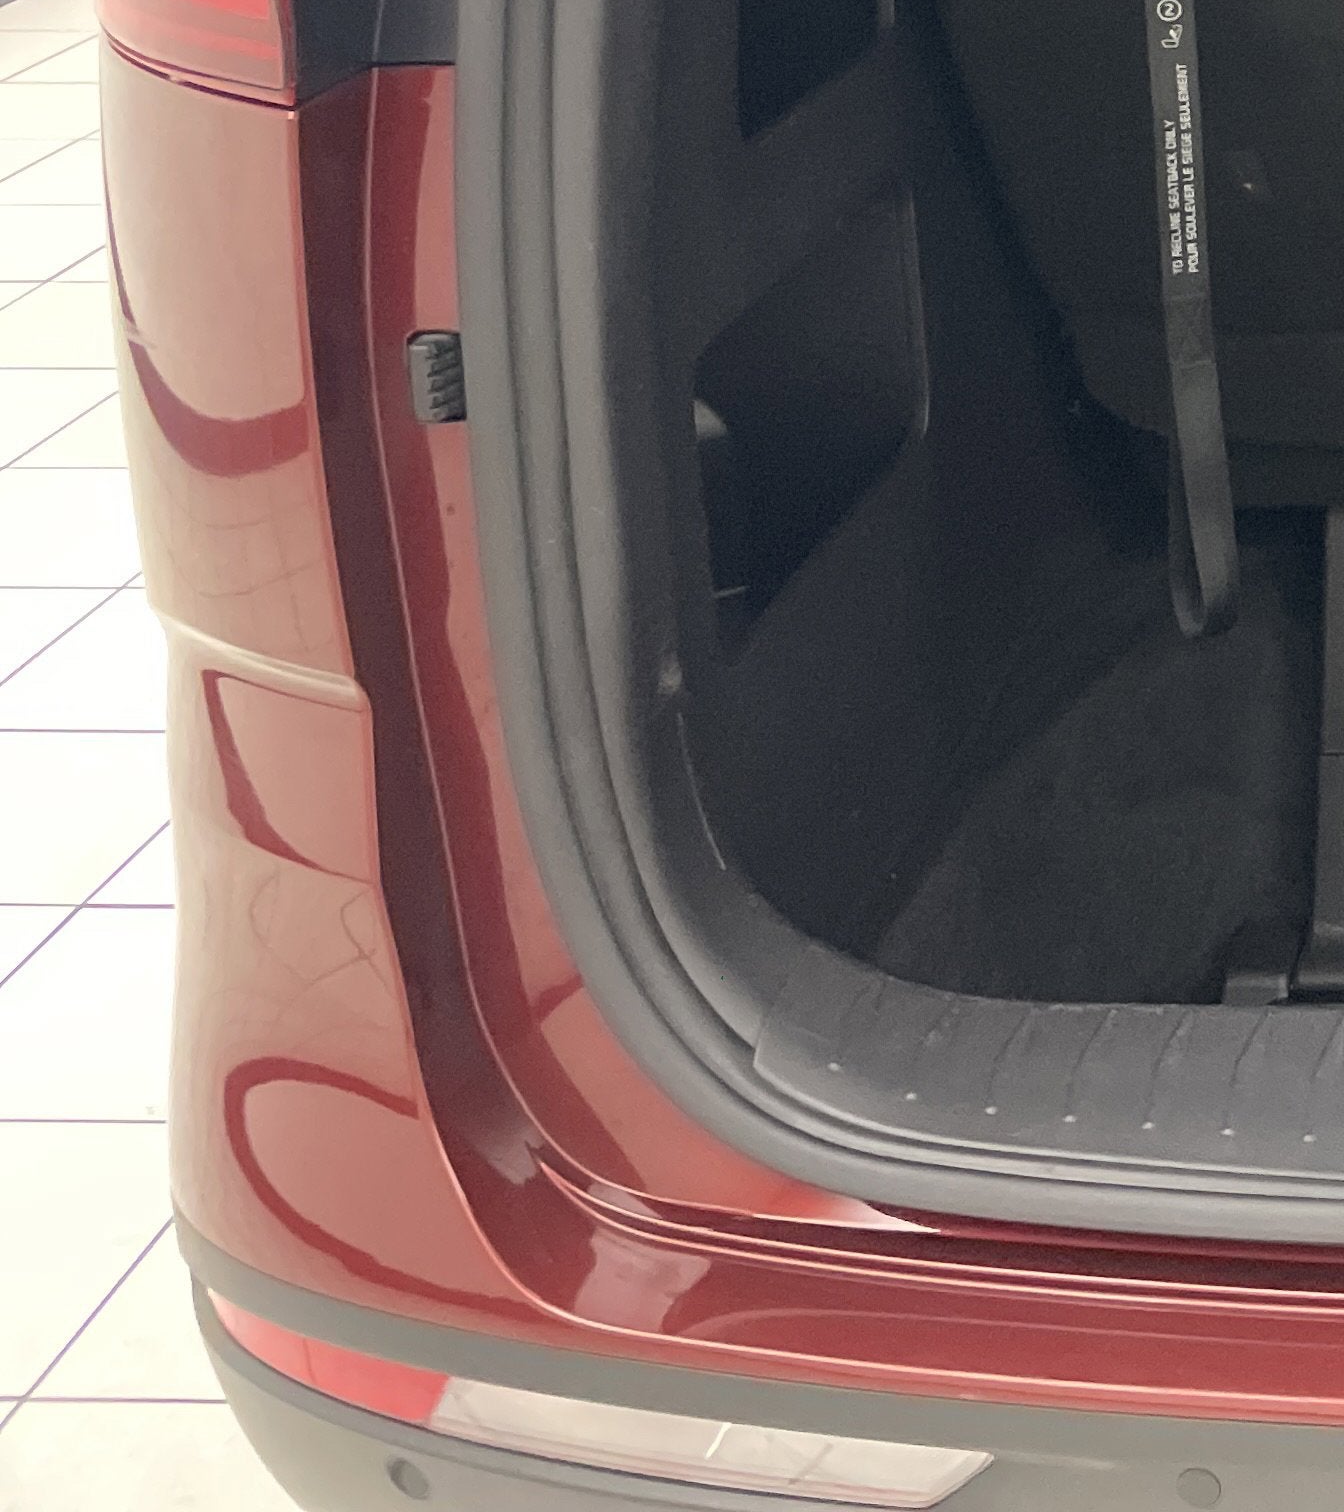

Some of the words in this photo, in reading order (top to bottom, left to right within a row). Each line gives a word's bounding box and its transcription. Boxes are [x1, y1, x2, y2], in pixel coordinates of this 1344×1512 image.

[1175, 63, 1191, 130] SEULEMENT
[1163, 119, 1176, 150] ONLY
[1166, 152, 1180, 209] SEATBACK
[1182, 167, 1195, 182] LE
[1183, 184, 1197, 240] SOULEVER
[1168, 211, 1183, 257] RECLINE
[1172, 259, 1184, 274] TO
[1185, 242, 1199, 273] POUR
